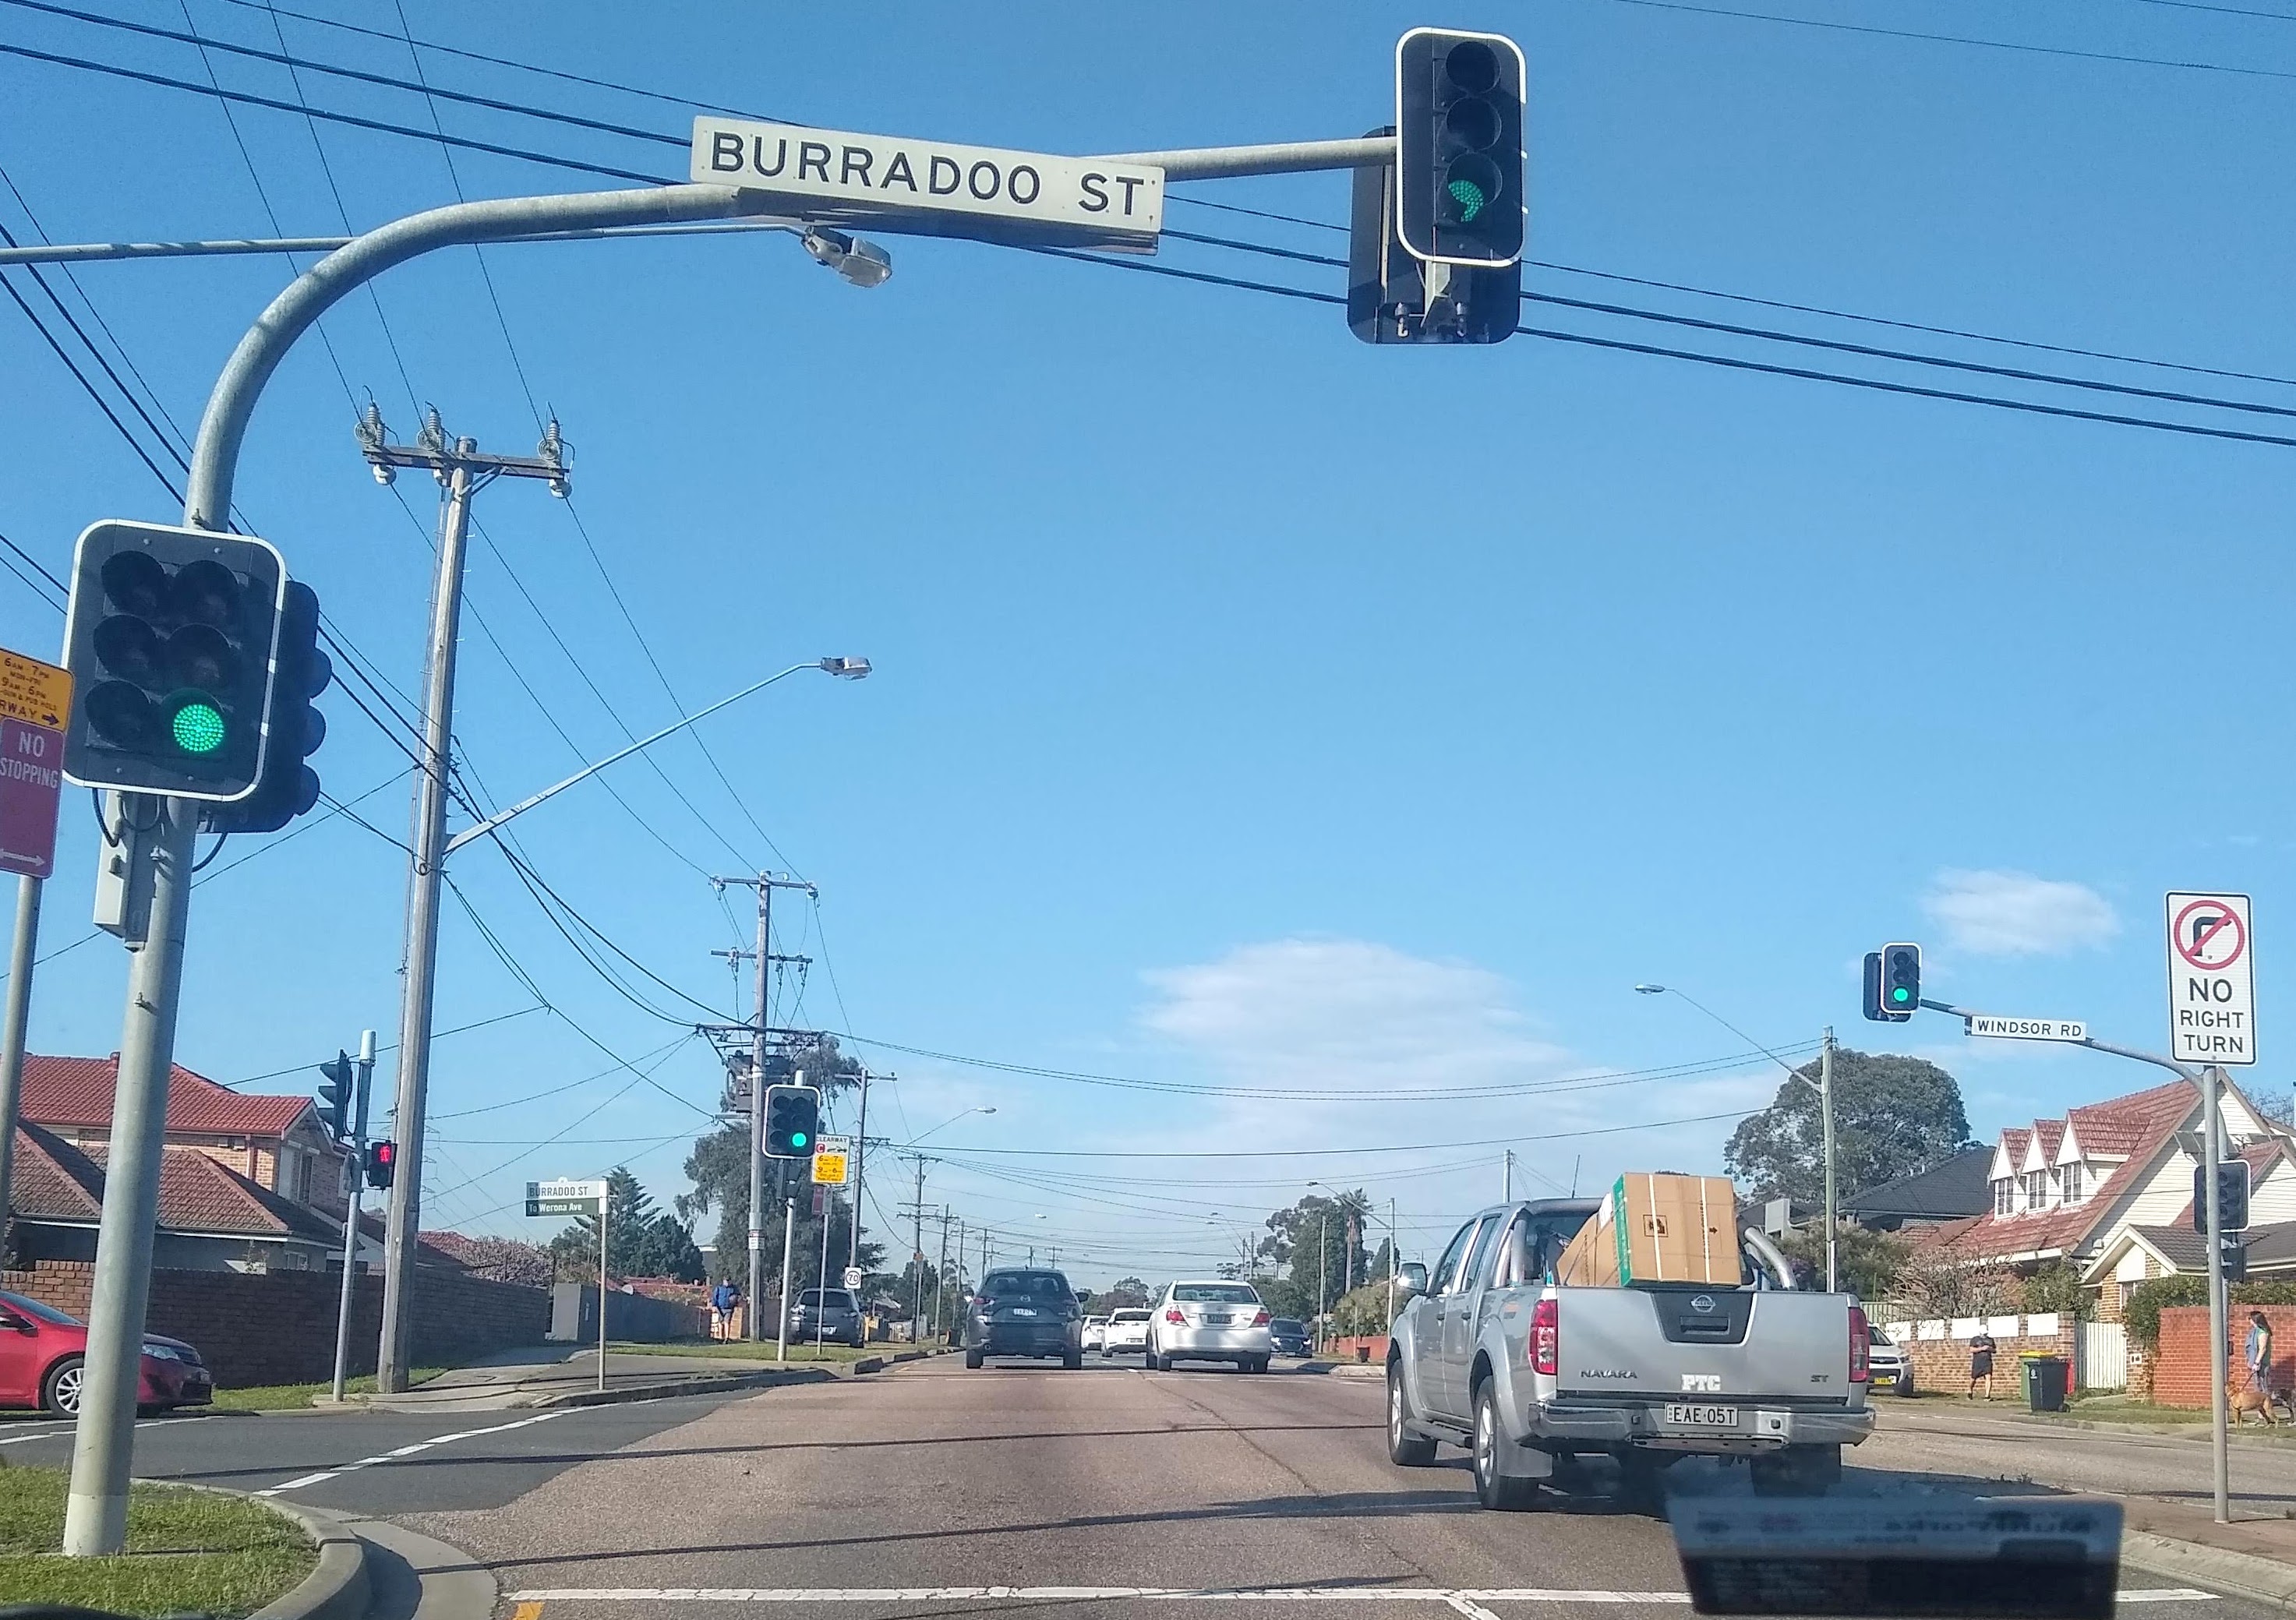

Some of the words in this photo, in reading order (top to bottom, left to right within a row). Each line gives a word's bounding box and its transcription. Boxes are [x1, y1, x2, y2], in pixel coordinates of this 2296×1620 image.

[711, 130, 1040, 205] BURRADOO
[1077, 171, 1145, 217] ST
[19, 731, 45, 758] NO
[0, 757, 59, 789] STOPPING
[2188, 977, 2233, 1004] NO
[1977, 1019, 2051, 1036] WINDSOR
[2060, 1024, 2082, 1037] RD
[2180, 1009, 2245, 1029] RIGHT
[2183, 1033, 2244, 1054] TURN
[529, 1187, 575, 1197] BURRADOO
[578, 1186, 588, 1196] ST
[528, 1203, 538, 1212] To
[539, 1202, 567, 1212] Werona
[568, 1202, 583, 1212] Ave
[1579, 1369, 1638, 1379] NAVARA
[1681, 1374, 1721, 1392] PTC
